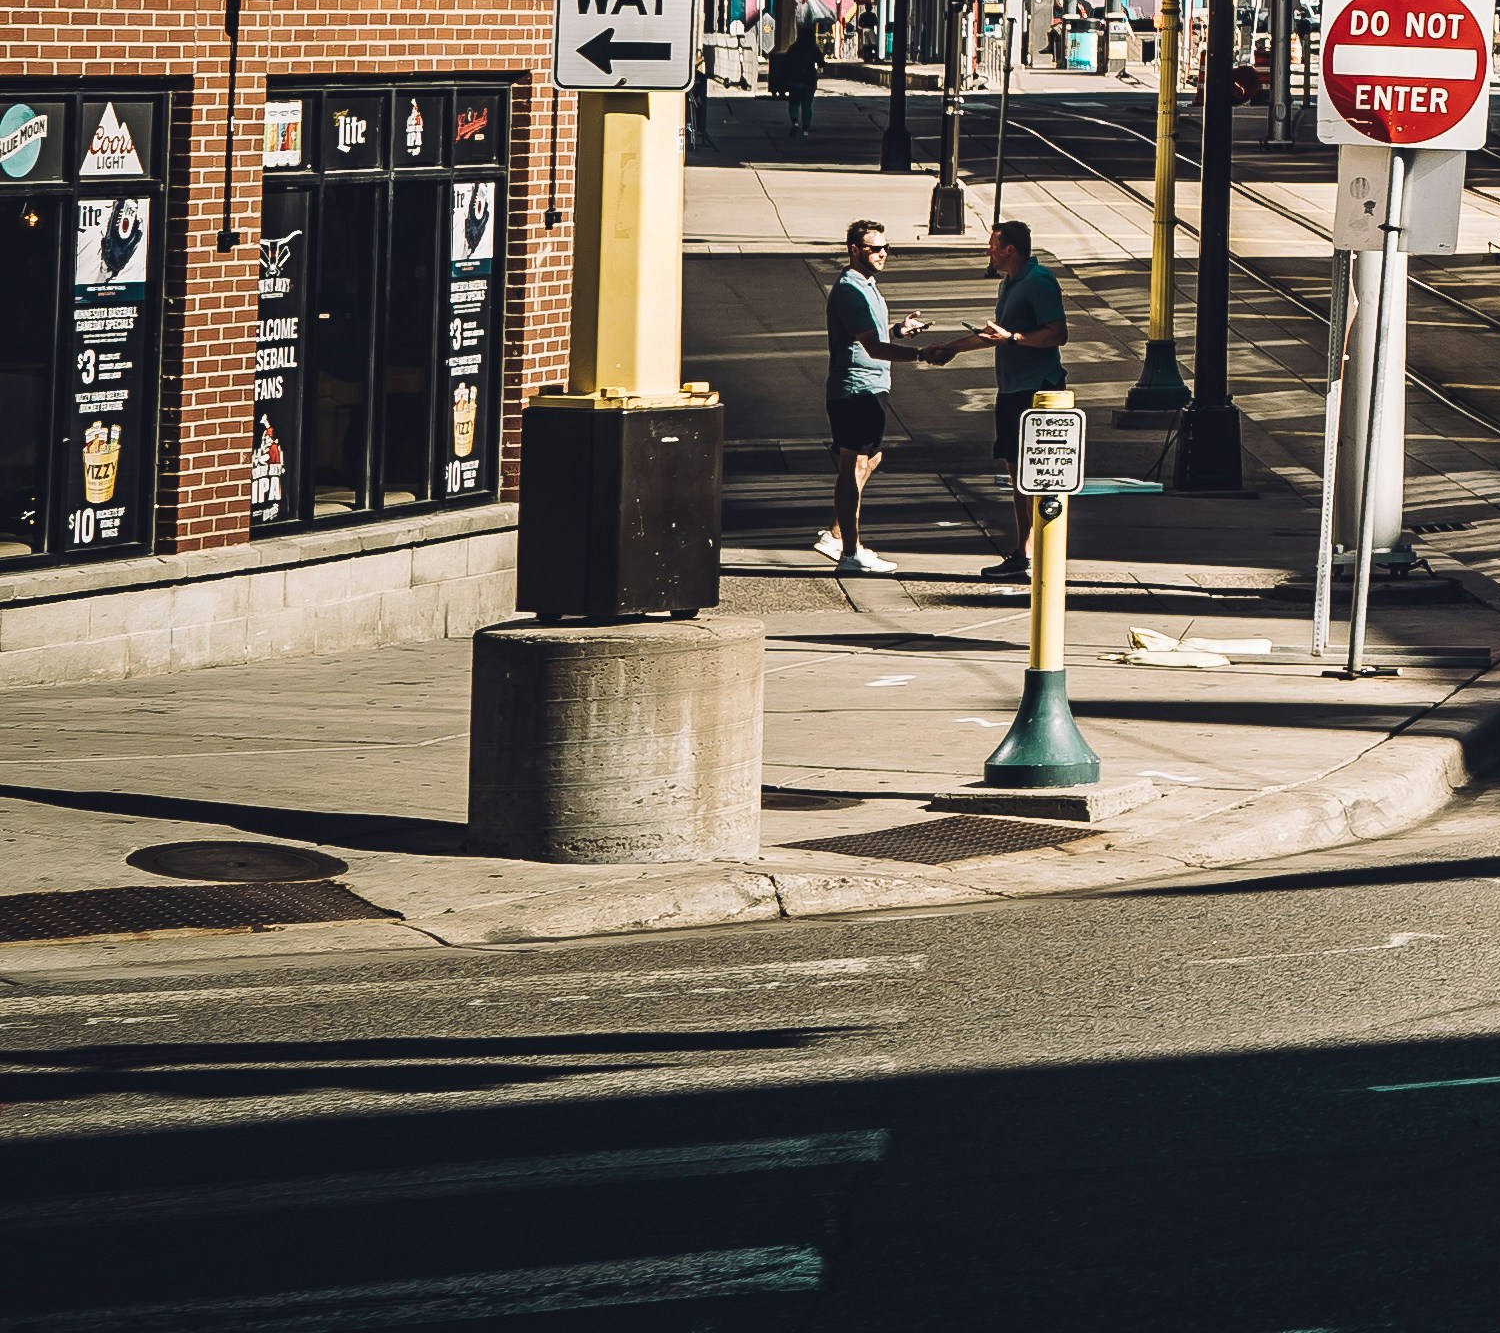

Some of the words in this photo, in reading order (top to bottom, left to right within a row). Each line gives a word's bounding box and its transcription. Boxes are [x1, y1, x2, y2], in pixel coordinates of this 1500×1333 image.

[1350, 10, 1390, 37] DO
[1405, 12, 1464, 40] NOT
[1355, 85, 1449, 114] ENTER
[0, 133, 19, 156] LUE
[19, 119, 46, 145] MOON
[90, 125, 135, 156] Coors
[337, 116, 367, 153] Lite
[96, 155, 126, 170] LIGHT
[256, 317, 298, 343] ELCOME
[77, 349, 96, 384] $3
[256, 346, 298, 371] SEBALL
[254, 376, 284, 401] FANS
[1031, 418, 1042, 427] TO
[1035, 429, 1069, 438] STREET
[1026, 447, 1046, 455] PUSH
[1048, 447, 1077, 455] BUTTON
[1029, 458, 1050, 466] WAIT
[1055, 458, 1073, 466] FOR
[1033, 479, 1066, 488] SIGNAL
[1036, 469, 1064, 477] WALK
[252, 477, 281, 504] IPA
[69, 507, 95, 544] $10
